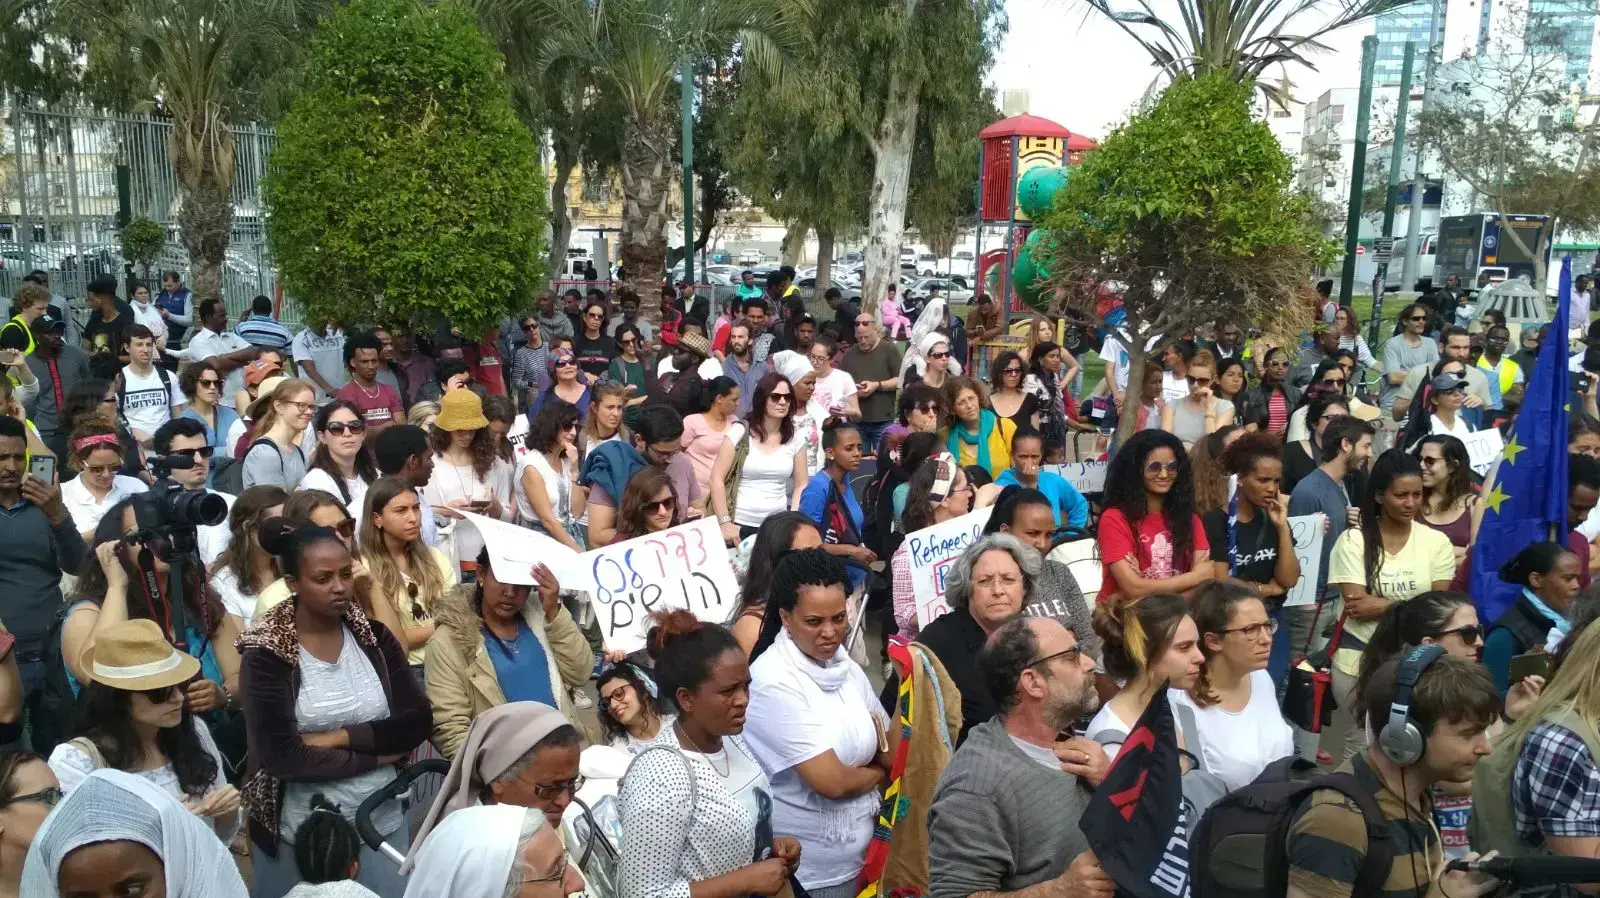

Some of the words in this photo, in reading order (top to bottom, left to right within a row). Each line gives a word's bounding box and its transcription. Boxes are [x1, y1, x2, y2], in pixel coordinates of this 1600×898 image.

[910, 532, 968, 568] Refugees
[146, 570, 160, 599] Canon
[1382, 581, 1417, 592] TIME
